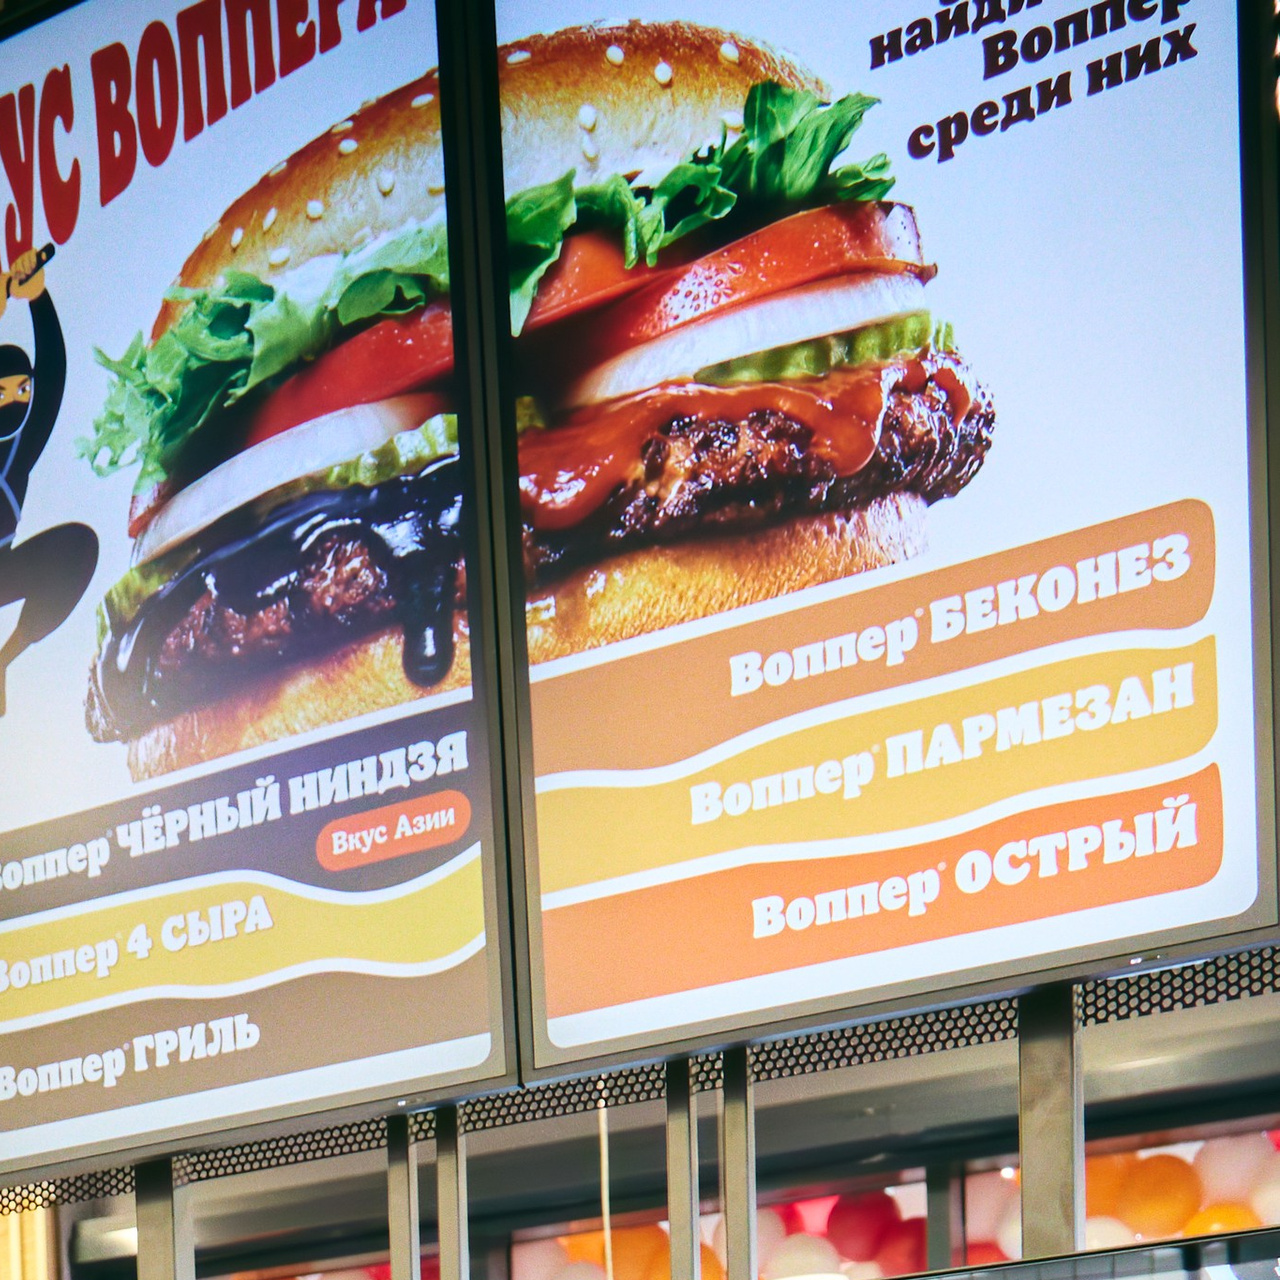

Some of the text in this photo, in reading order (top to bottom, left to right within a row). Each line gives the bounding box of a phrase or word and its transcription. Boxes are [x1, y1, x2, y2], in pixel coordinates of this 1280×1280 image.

[907, 71, 1073, 164] среди
[1086, 23, 1199, 96] них
[729, 532, 1192, 698] Воппер БЕКОНЕЗ
[116, 776, 282, 858] ЧЁРНЫЙ
[288, 730, 469, 816] НИНДЗЯ
[690, 662, 1195, 825] Воппер ПАРМЕЗАН
[330, 804, 456, 857] Вкус Азии
[751, 793, 1199, 940] Воппер ОСТРЫЙ
[127, 924, 154, 961] 4
[162, 895, 274, 953] СЫРА
[132, 1012, 261, 1072] ГРИЛЬ
